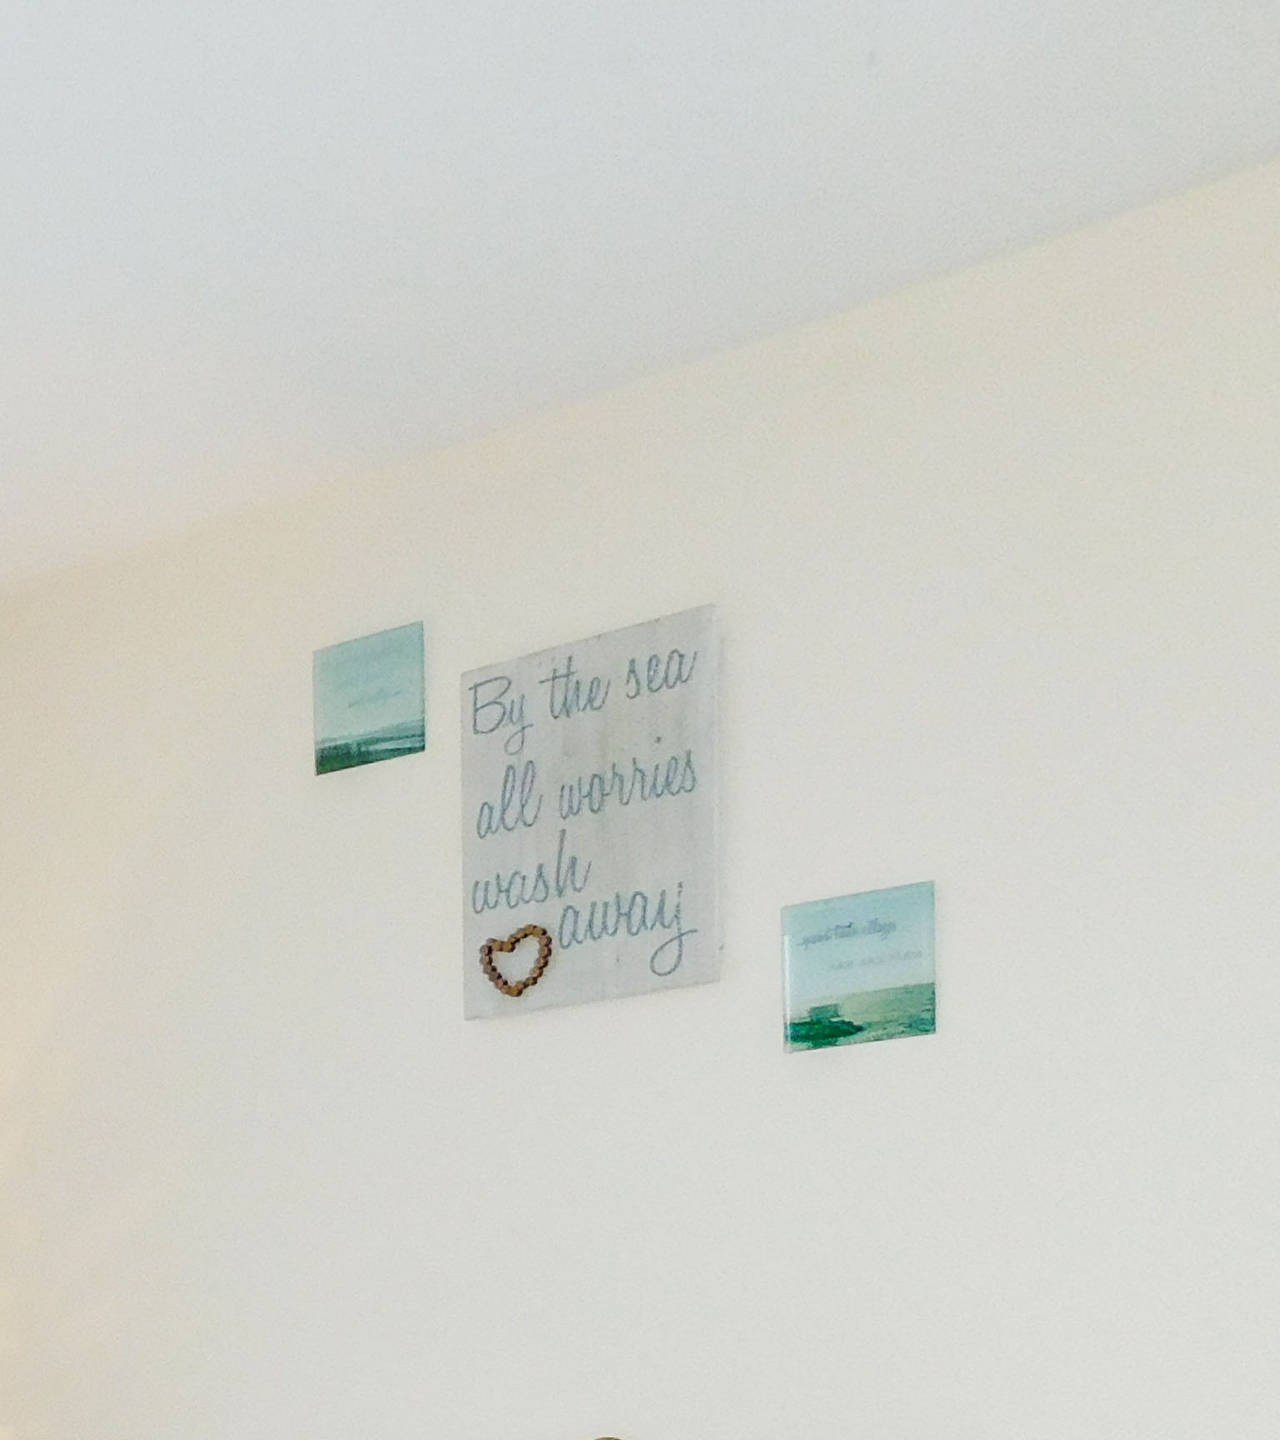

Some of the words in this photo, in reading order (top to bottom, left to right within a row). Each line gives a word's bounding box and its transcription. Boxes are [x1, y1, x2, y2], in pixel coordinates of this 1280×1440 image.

[468, 675, 534, 756] By
[539, 655, 611, 720] the
[625, 648, 698, 700] sea
[476, 760, 544, 840] all
[558, 736, 697, 821] worries
[471, 828, 592, 915] wash
[558, 880, 699, 977] away
